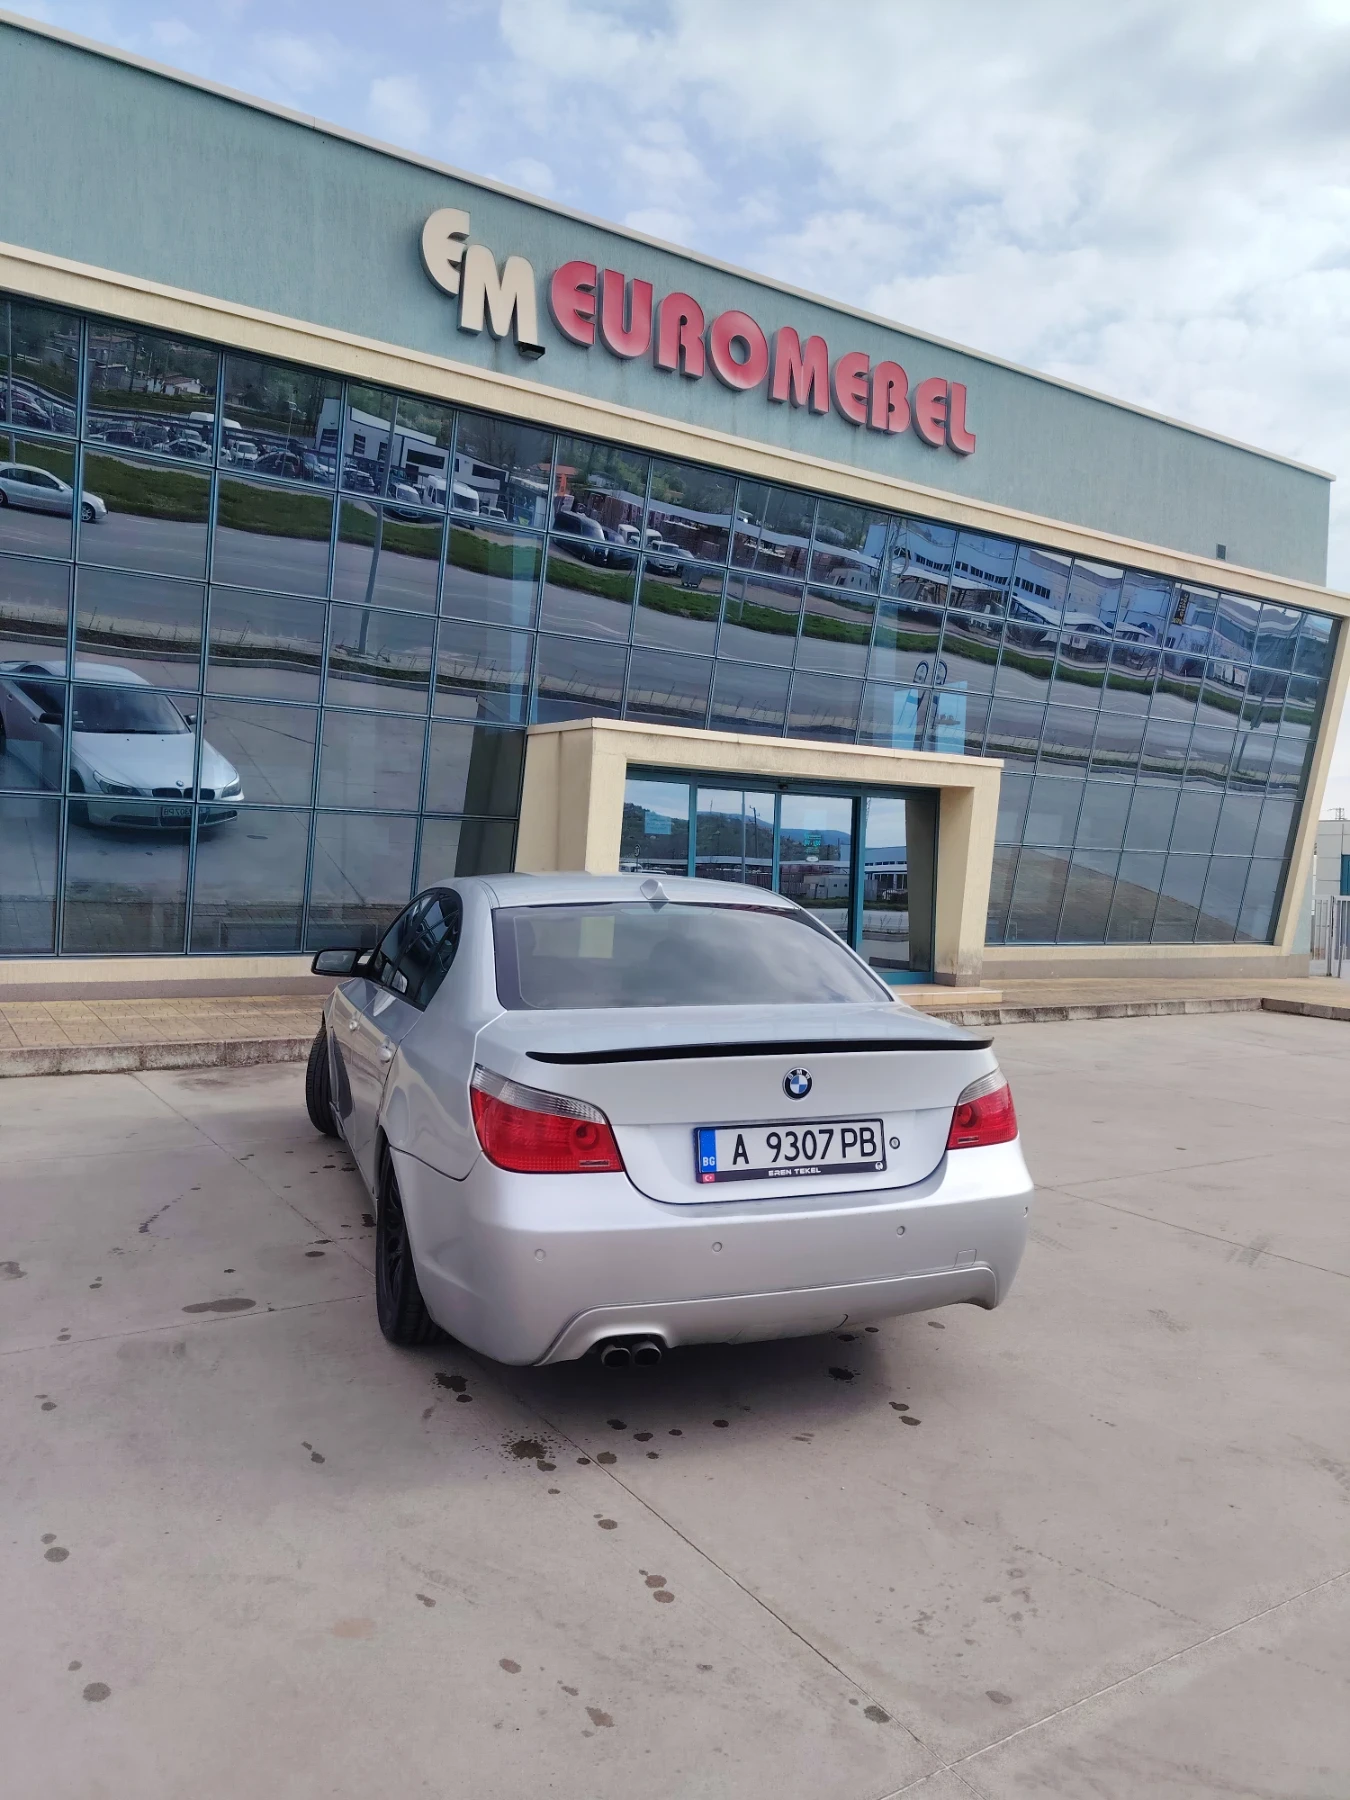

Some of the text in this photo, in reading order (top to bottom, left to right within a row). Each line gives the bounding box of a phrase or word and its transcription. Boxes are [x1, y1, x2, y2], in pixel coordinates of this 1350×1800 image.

[548, 260, 976, 456] EUROMEBEL
[732, 1133, 750, 1165] A
[702, 1156, 716, 1167] BG
[768, 1166, 822, 1177] EREN TEKEL
